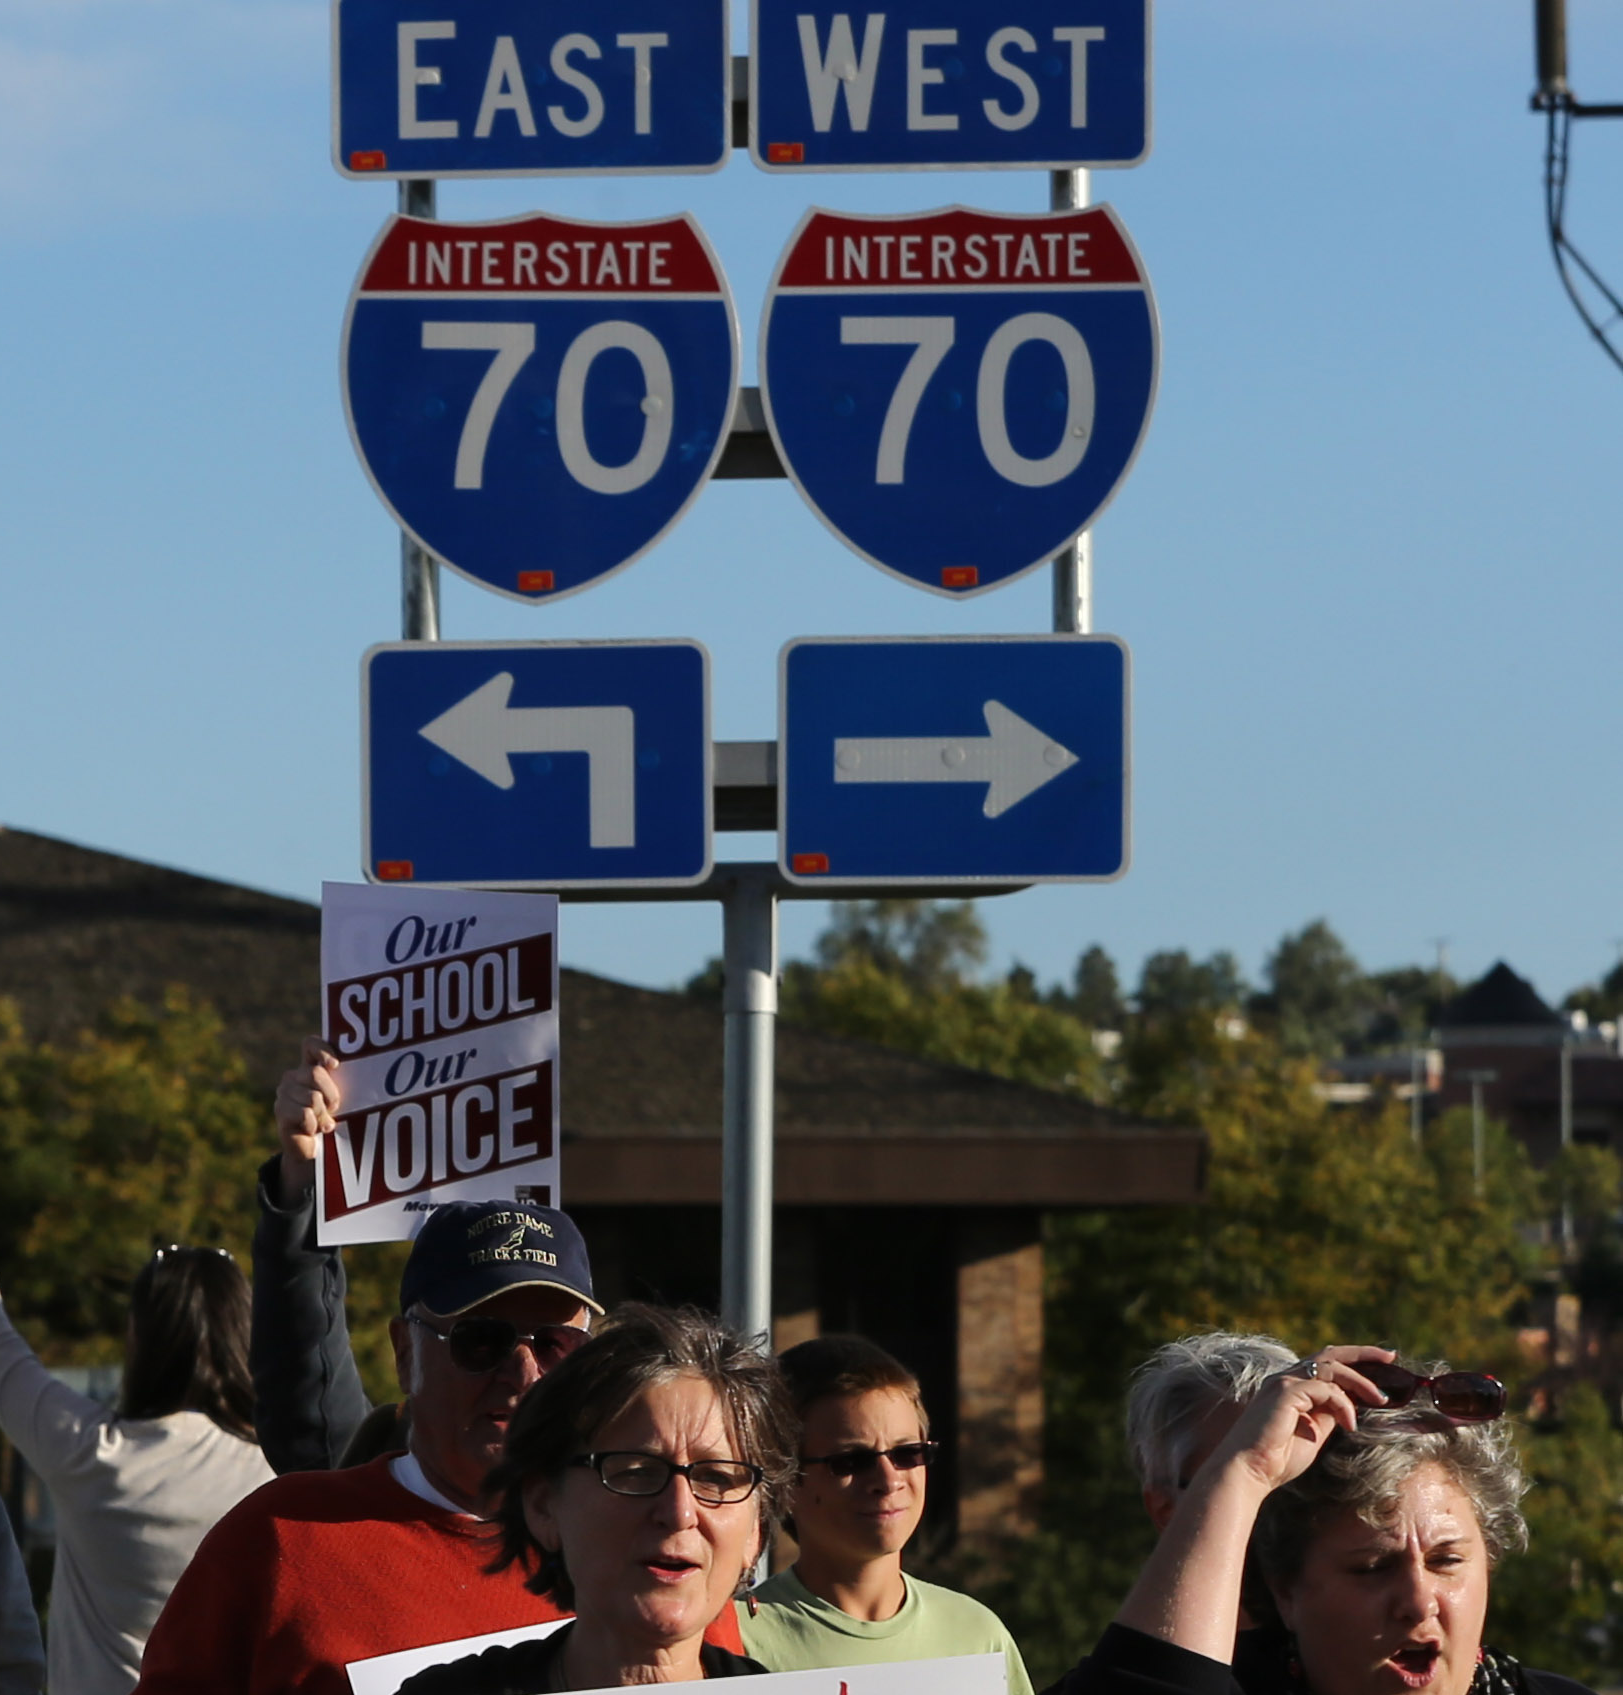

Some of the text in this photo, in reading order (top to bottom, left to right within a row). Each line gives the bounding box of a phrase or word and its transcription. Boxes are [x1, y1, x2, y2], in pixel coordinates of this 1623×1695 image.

[397, 21, 668, 140] EAST
[797, 14, 1105, 132] WEST
[407, 240, 673, 287] INTERSTATE
[825, 232, 1093, 281] INTERSTATE
[421, 319, 675, 496] 70
[840, 311, 1096, 488] 70
[385, 914, 477, 966] Our
[338, 946, 535, 1056] SCHOOL
[384, 1047, 477, 1098] Our
[334, 1070, 539, 1210] VOICE
[467, 1211, 554, 1240] NOTRE DAME
[467, 1248, 511, 1265] TRACK
[523, 1248, 557, 1267] FIELD
